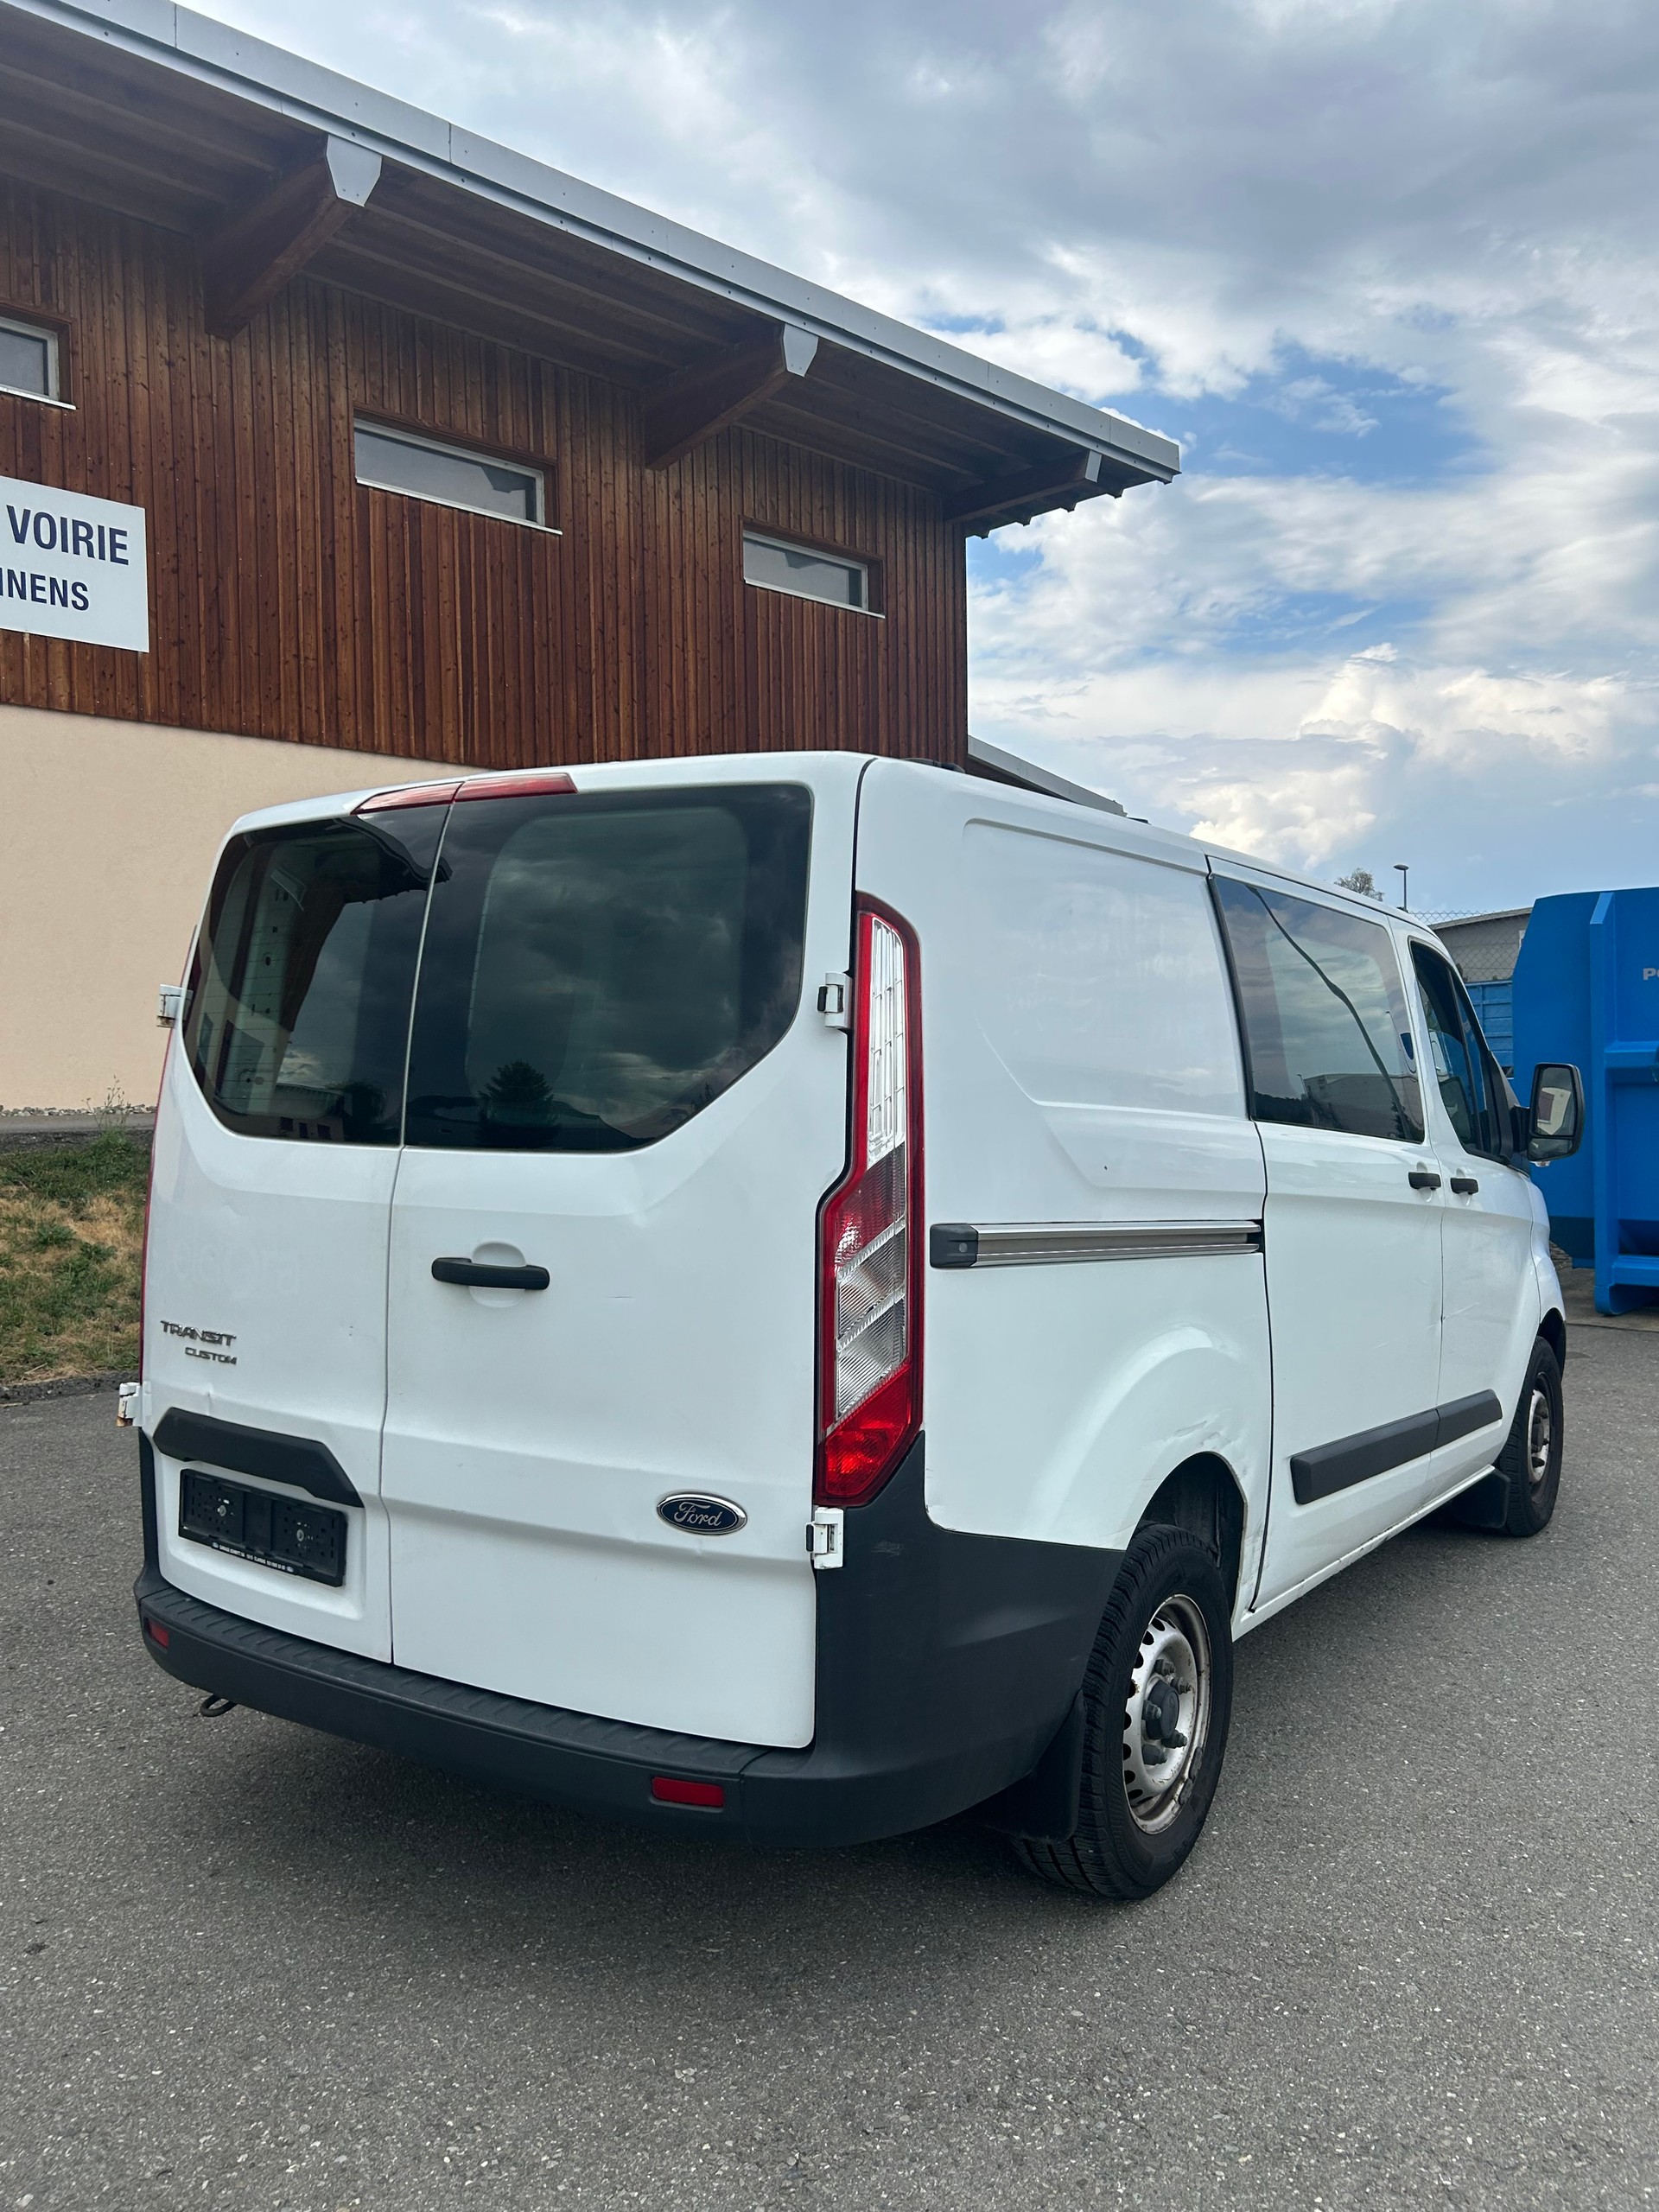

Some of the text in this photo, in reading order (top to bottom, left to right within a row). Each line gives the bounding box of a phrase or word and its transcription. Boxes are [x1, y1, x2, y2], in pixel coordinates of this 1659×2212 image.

[6, 504, 129, 566] VOIRIE
[0, 567, 89, 611] NENS
[160, 1320, 237, 1346] TRANSIT
[184, 1346, 238, 1365] CUSTOM
[673, 1501, 723, 1527] Ford
